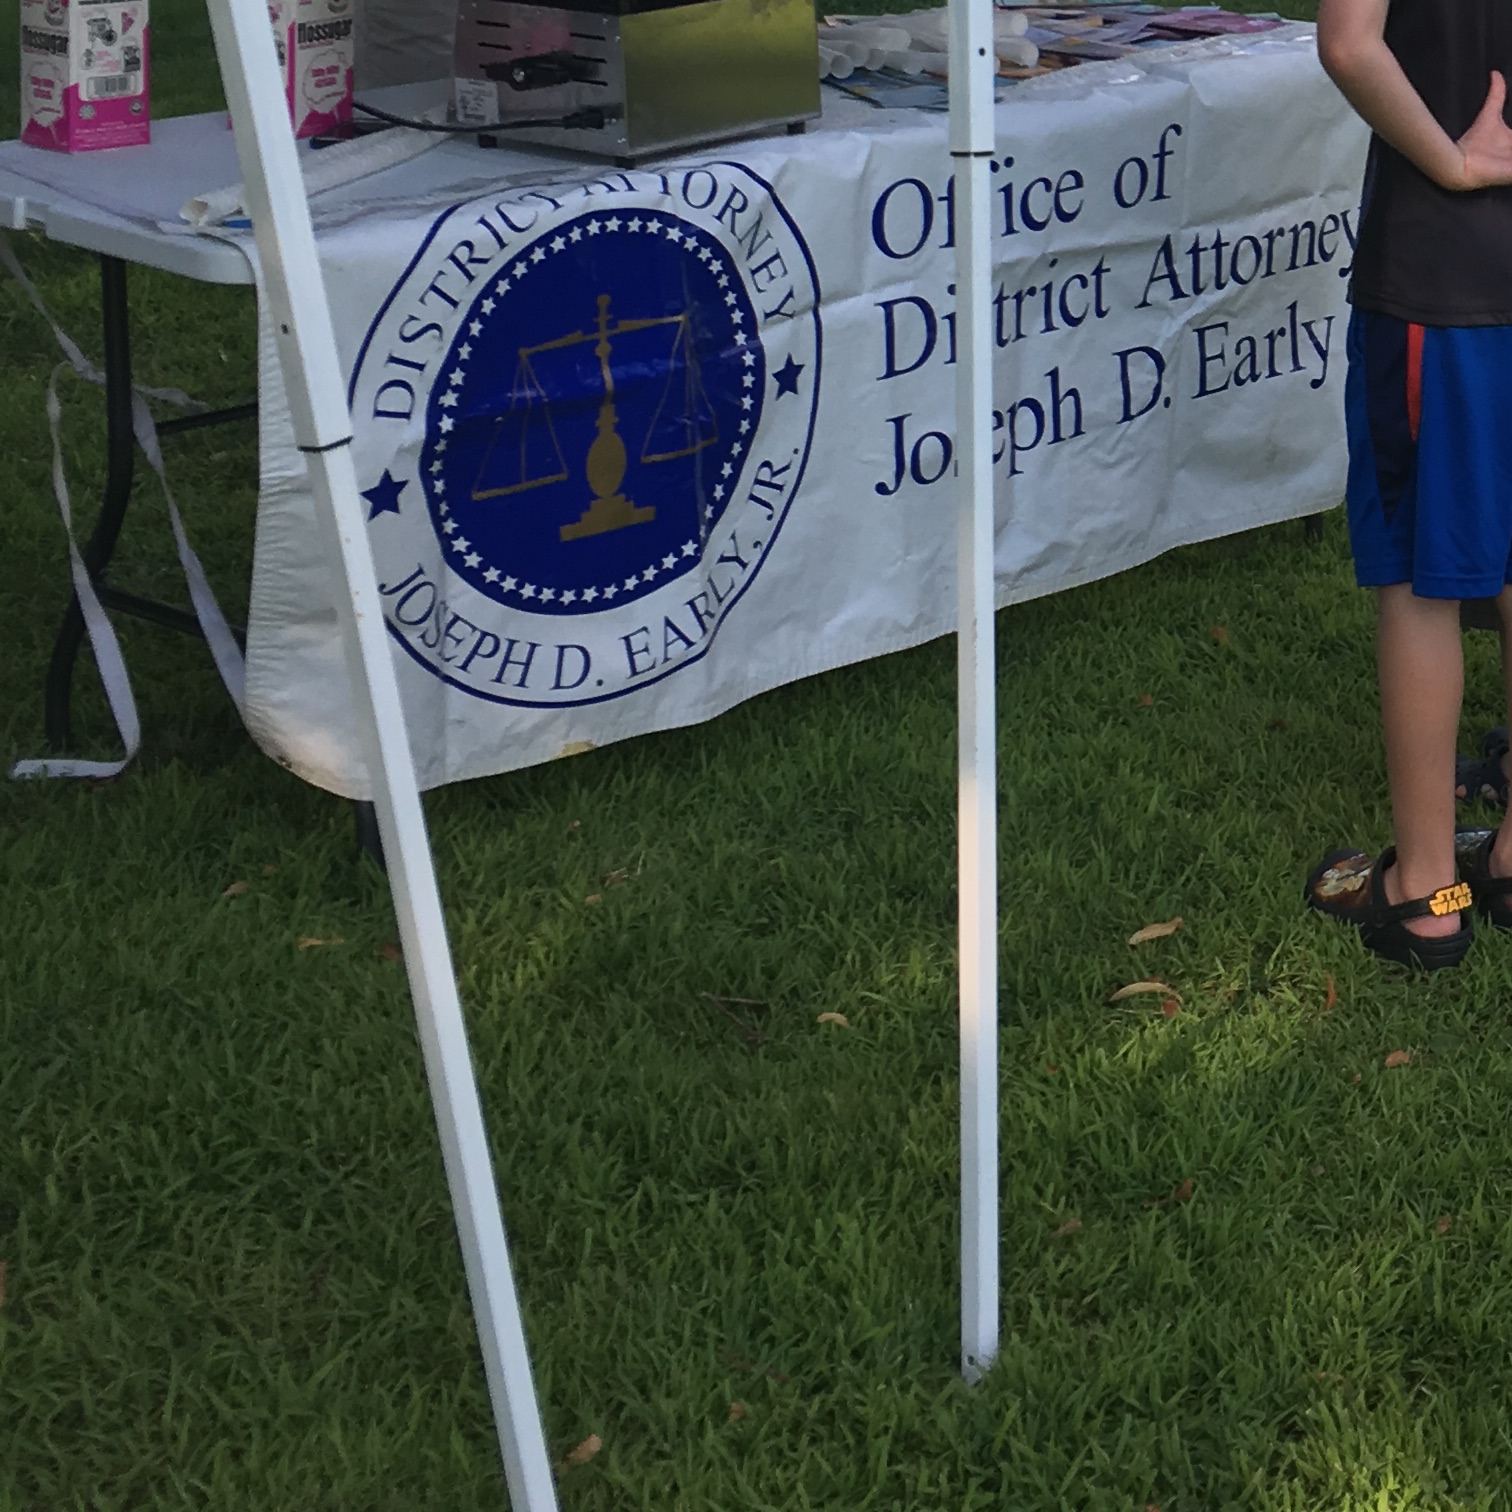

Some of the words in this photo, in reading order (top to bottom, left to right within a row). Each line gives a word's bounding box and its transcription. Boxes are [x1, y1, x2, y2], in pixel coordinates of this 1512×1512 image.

[871, 155, 1085, 260] Ofice
[1113, 123, 1182, 210] of
[873, 254, 1112, 382] Ditrict
[1132, 205, 1361, 311] Attorney
[873, 366, 1087, 496] Joeph
[1112, 344, 1173, 426] D.
[1191, 299, 1336, 401] Early
[377, 561, 543, 690] JOSEPH
[549, 642, 605, 691] D.
[618, 530, 763, 679] EARLY,
[748, 446, 800, 522] JR.
[1429, 882, 1471, 905] STAR
[1430, 892, 1472, 916] WARS
